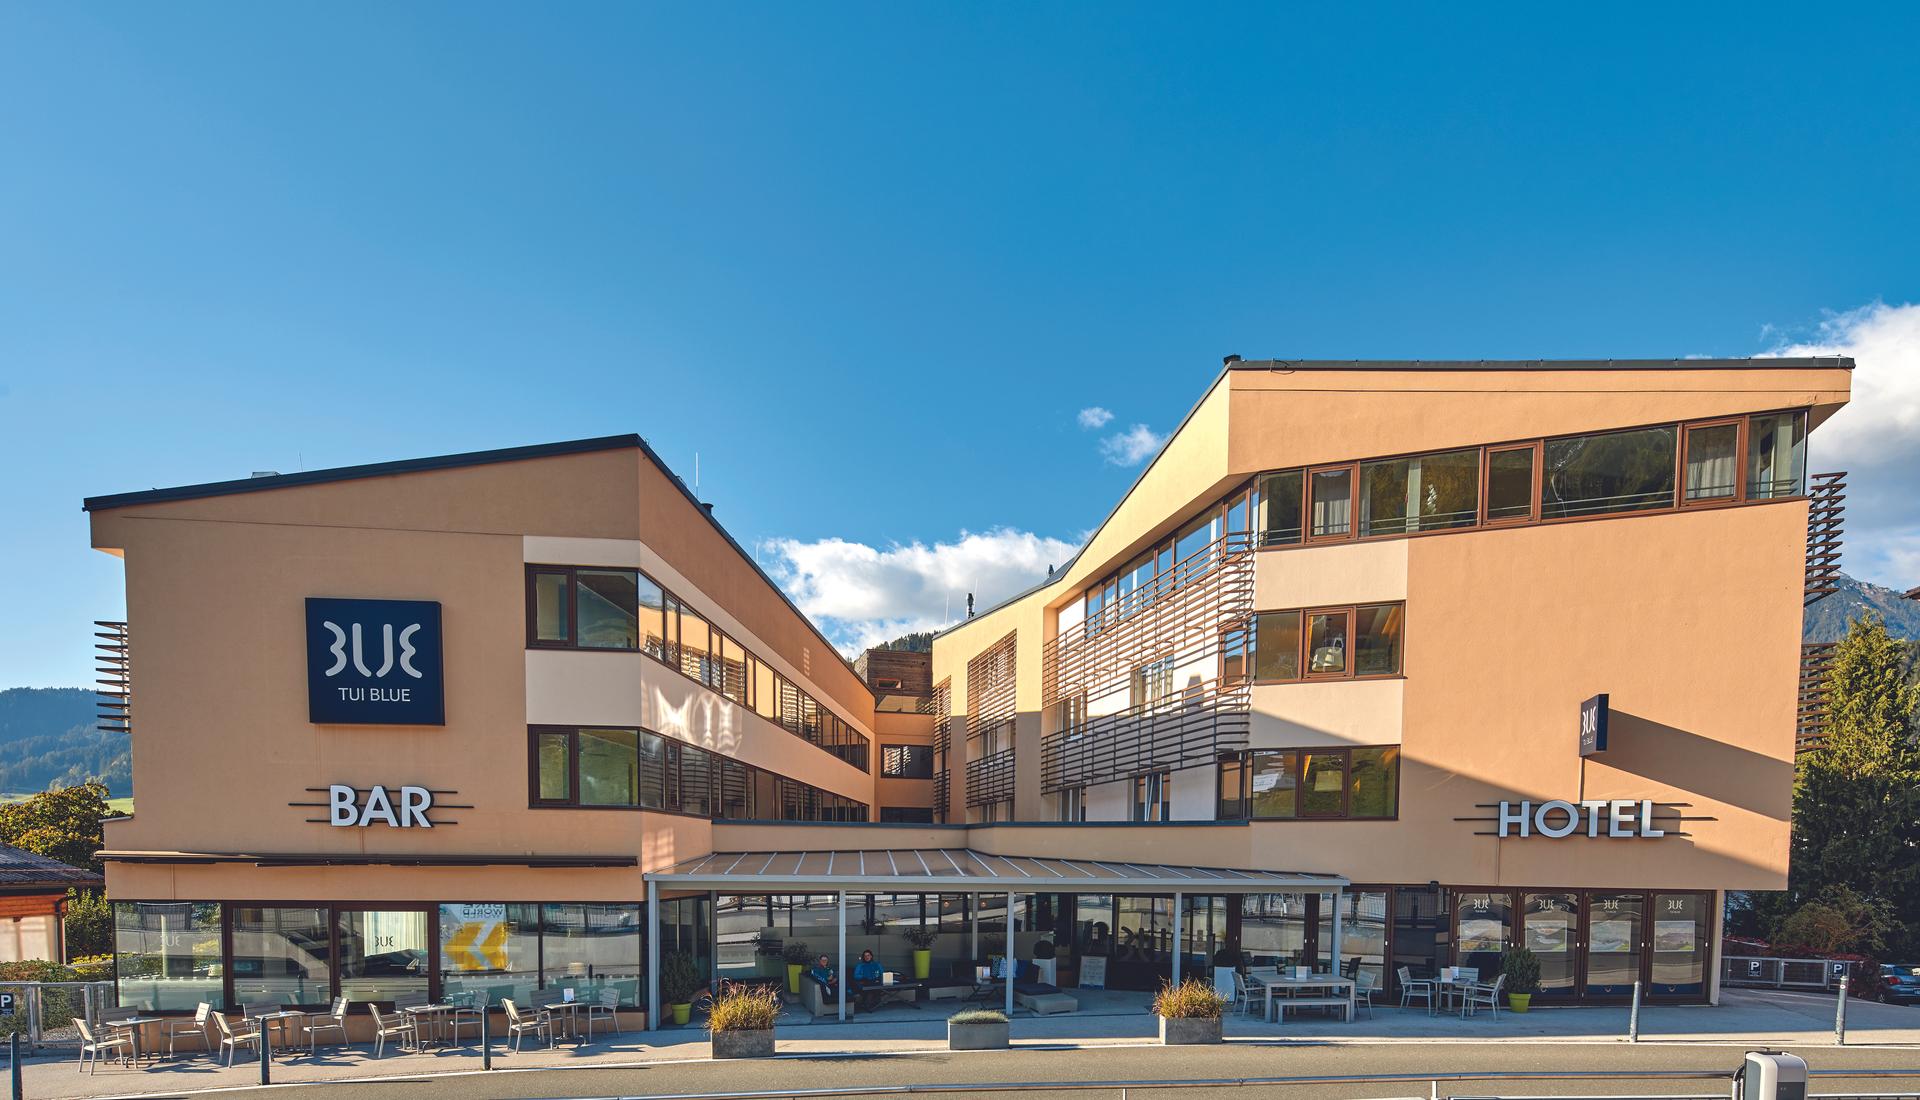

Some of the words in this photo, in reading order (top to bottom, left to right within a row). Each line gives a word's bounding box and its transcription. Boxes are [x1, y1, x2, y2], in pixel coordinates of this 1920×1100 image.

[338, 687, 365, 701] TUI
[370, 688, 411, 702] BLUE
[329, 784, 434, 828] BAR
[1498, 799, 1665, 839] HOTEL
[1750, 961, 1760, 971] P
[1833, 964, 1843, 973] P
[1, 995, 12, 1008] P
